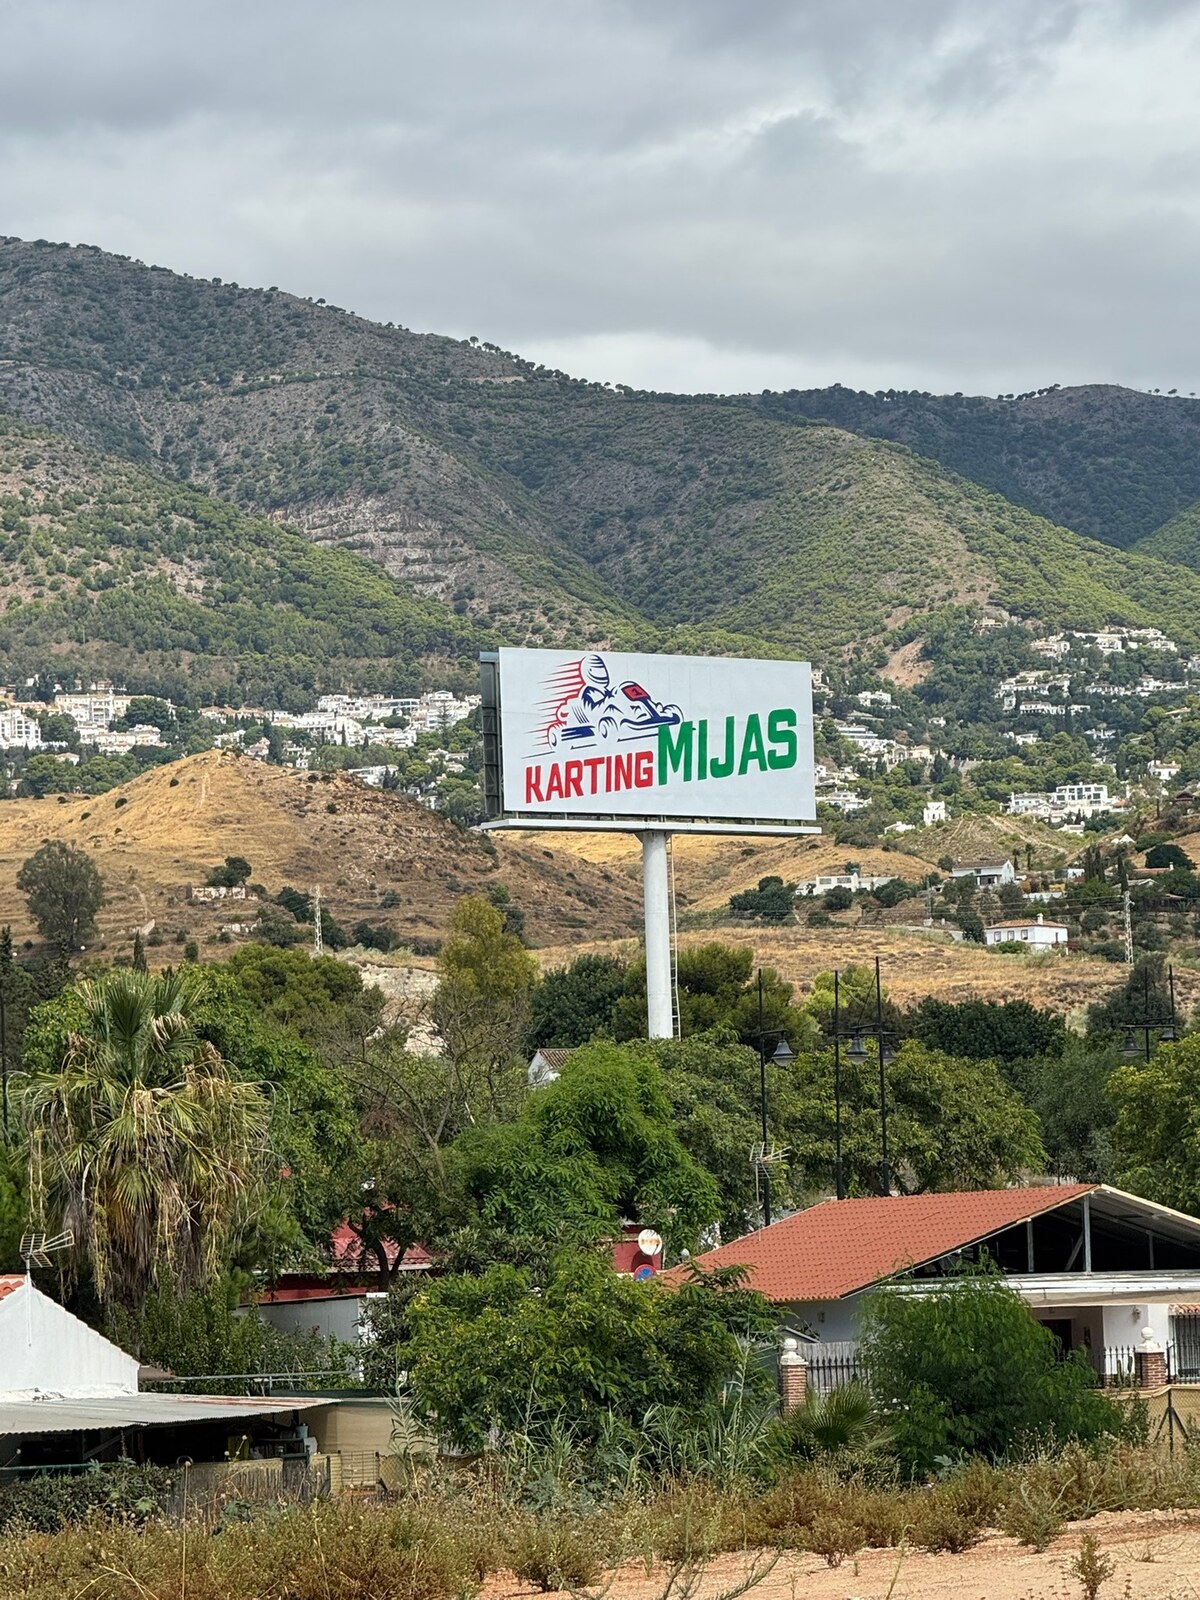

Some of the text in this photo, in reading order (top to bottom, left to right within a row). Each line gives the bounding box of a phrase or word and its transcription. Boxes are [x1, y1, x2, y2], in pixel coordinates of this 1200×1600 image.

[631, 687, 642, 696] 1
[525, 708, 797, 803] KARTING MIJAS
